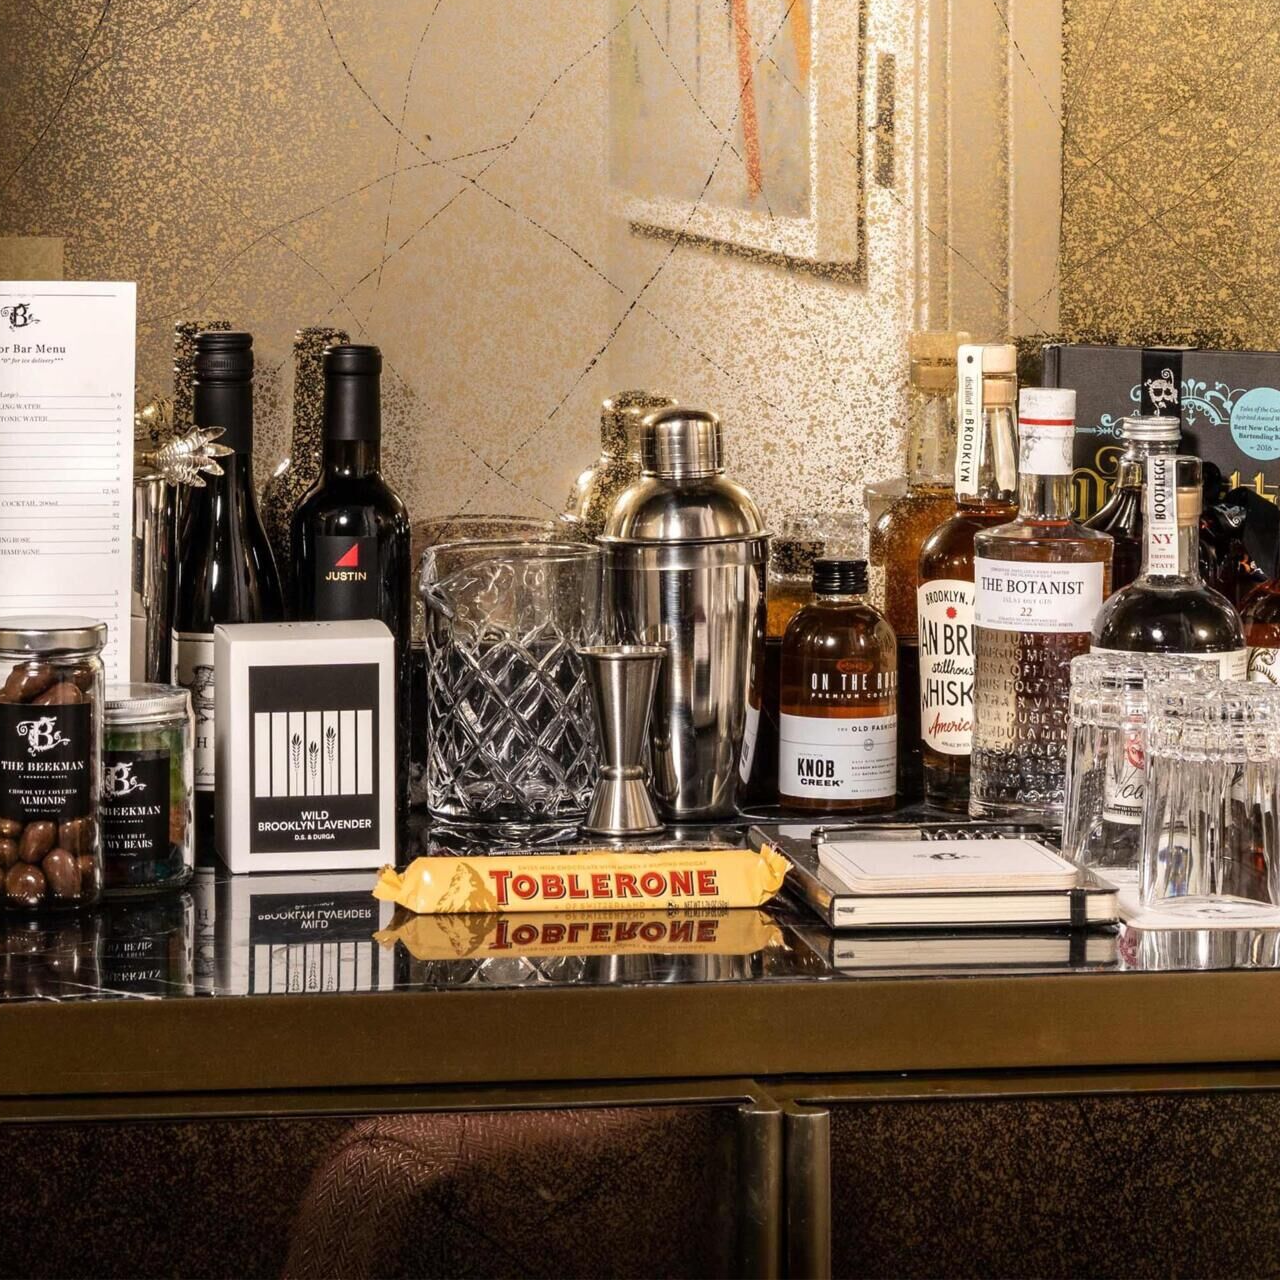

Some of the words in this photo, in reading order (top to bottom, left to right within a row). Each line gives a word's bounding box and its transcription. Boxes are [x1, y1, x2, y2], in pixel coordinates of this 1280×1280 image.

[13, 344, 32, 353] Bar
[36, 344, 66, 353] Menu
[965, 377, 973, 405] distilled
[961, 419, 974, 482] BROOKLYN
[1152, 534, 1173, 544] NY
[326, 571, 367, 582] JUSTIN
[981, 577, 1003, 592] THE
[1007, 580, 1084, 594] BOTANIST
[1020, 607, 1032, 616] 22
[921, 621, 938, 656] AN
[932, 659, 974, 676] stillhous
[812, 673, 828, 690] ON
[841, 674, 867, 690] THE
[922, 678, 974, 712] WHISK
[1, 761, 24, 771] THE
[28, 761, 84, 771] BEEKMAN
[798, 758, 834, 777] KNOB
[20, 796, 66, 805] ALMONDS
[301, 811, 329, 820] WILD
[258, 821, 315, 831] BROOKLYN
[318, 819, 371, 830] LAVENDER
[124, 840, 152, 848] BEARS
[489, 870, 718, 906] TOBLERONE
